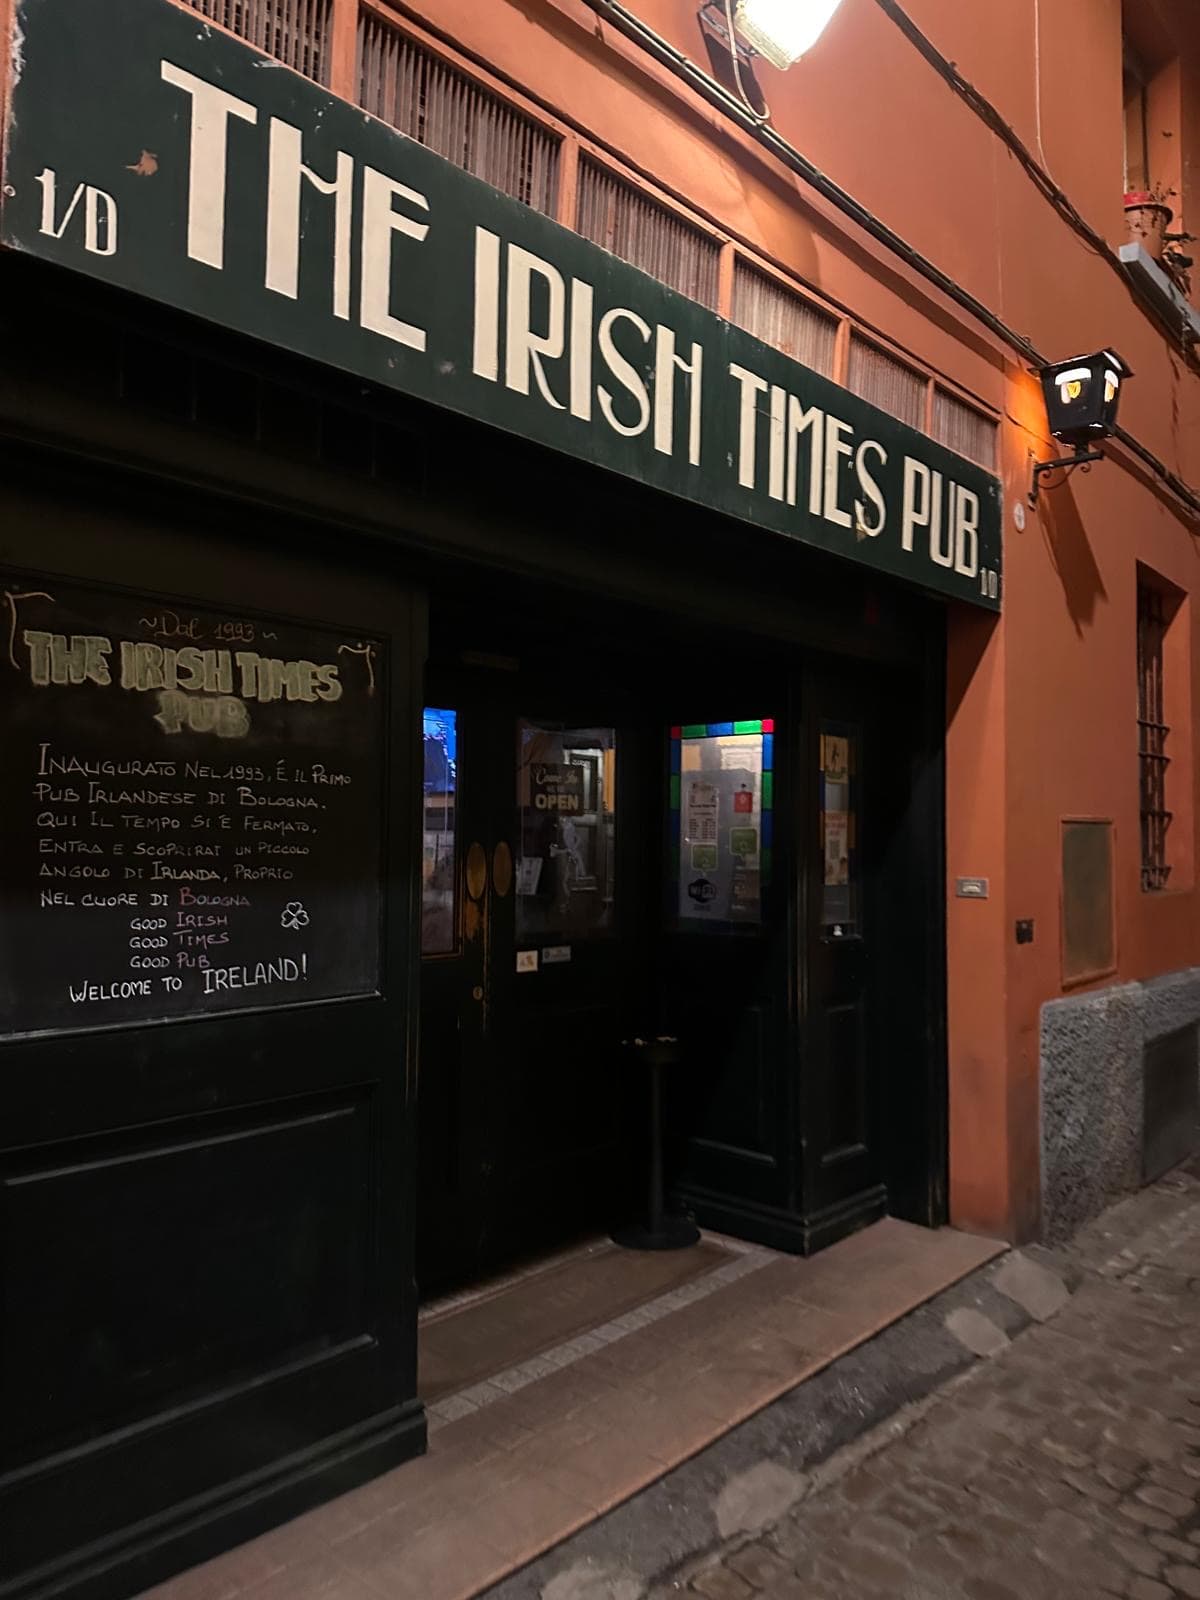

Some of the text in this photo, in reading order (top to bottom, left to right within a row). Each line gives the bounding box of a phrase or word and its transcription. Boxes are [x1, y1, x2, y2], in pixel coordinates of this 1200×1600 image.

[161, 59, 978, 578] THE IRISH TIMES PUB
[214, 622, 257, 642] 1993
[24, 629, 344, 702] THE IRISH TIMES
[153, 689, 252, 738] PUB
[208, 792, 225, 805] DI
[534, 792, 580, 811] OPEN
[90, 811, 113, 827] IL
[121, 814, 181, 833] TEMPO
[39, 838, 104, 854] ENTRA
[39, 864, 111, 878] ANGOLO
[124, 867, 144, 879] DI
[41, 888, 75, 907] NEL
[81, 893, 138, 906] CUORE
[149, 894, 168, 906] DI
[130, 917, 168, 931] GOOD
[129, 936, 168, 949] GOOD
[129, 954, 211, 968] GOOD PUB
[69, 978, 152, 1003] WELCOME
[161, 976, 183, 992] TO
